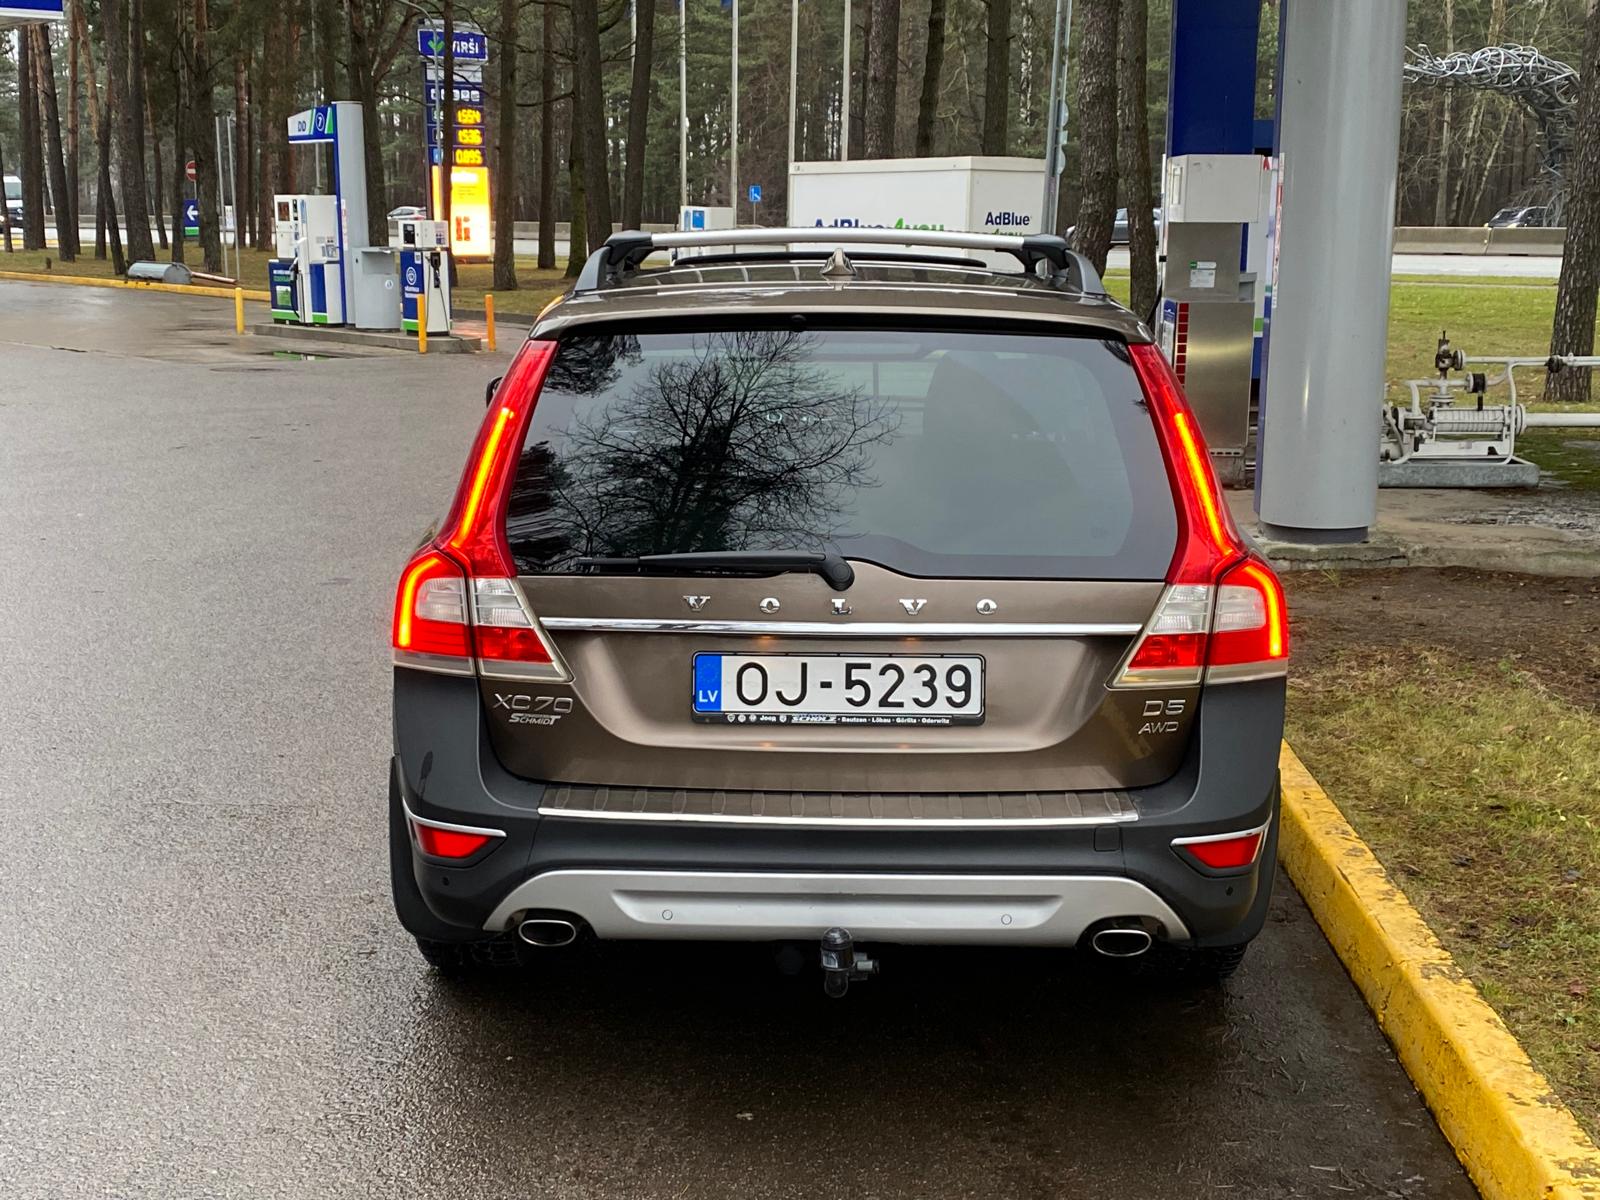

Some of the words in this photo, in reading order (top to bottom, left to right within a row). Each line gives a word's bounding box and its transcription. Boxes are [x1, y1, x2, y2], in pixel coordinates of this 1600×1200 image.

[985, 211, 1030, 226] AdBlue
[683, 595, 997, 615] VOLVO
[736, 661, 972, 708] OJ-5239
[699, 690, 718, 703] LV
[1142, 699, 1186, 716] D5
[508, 712, 562, 726] SCHMIDT
[1138, 721, 1179, 734] AWD
